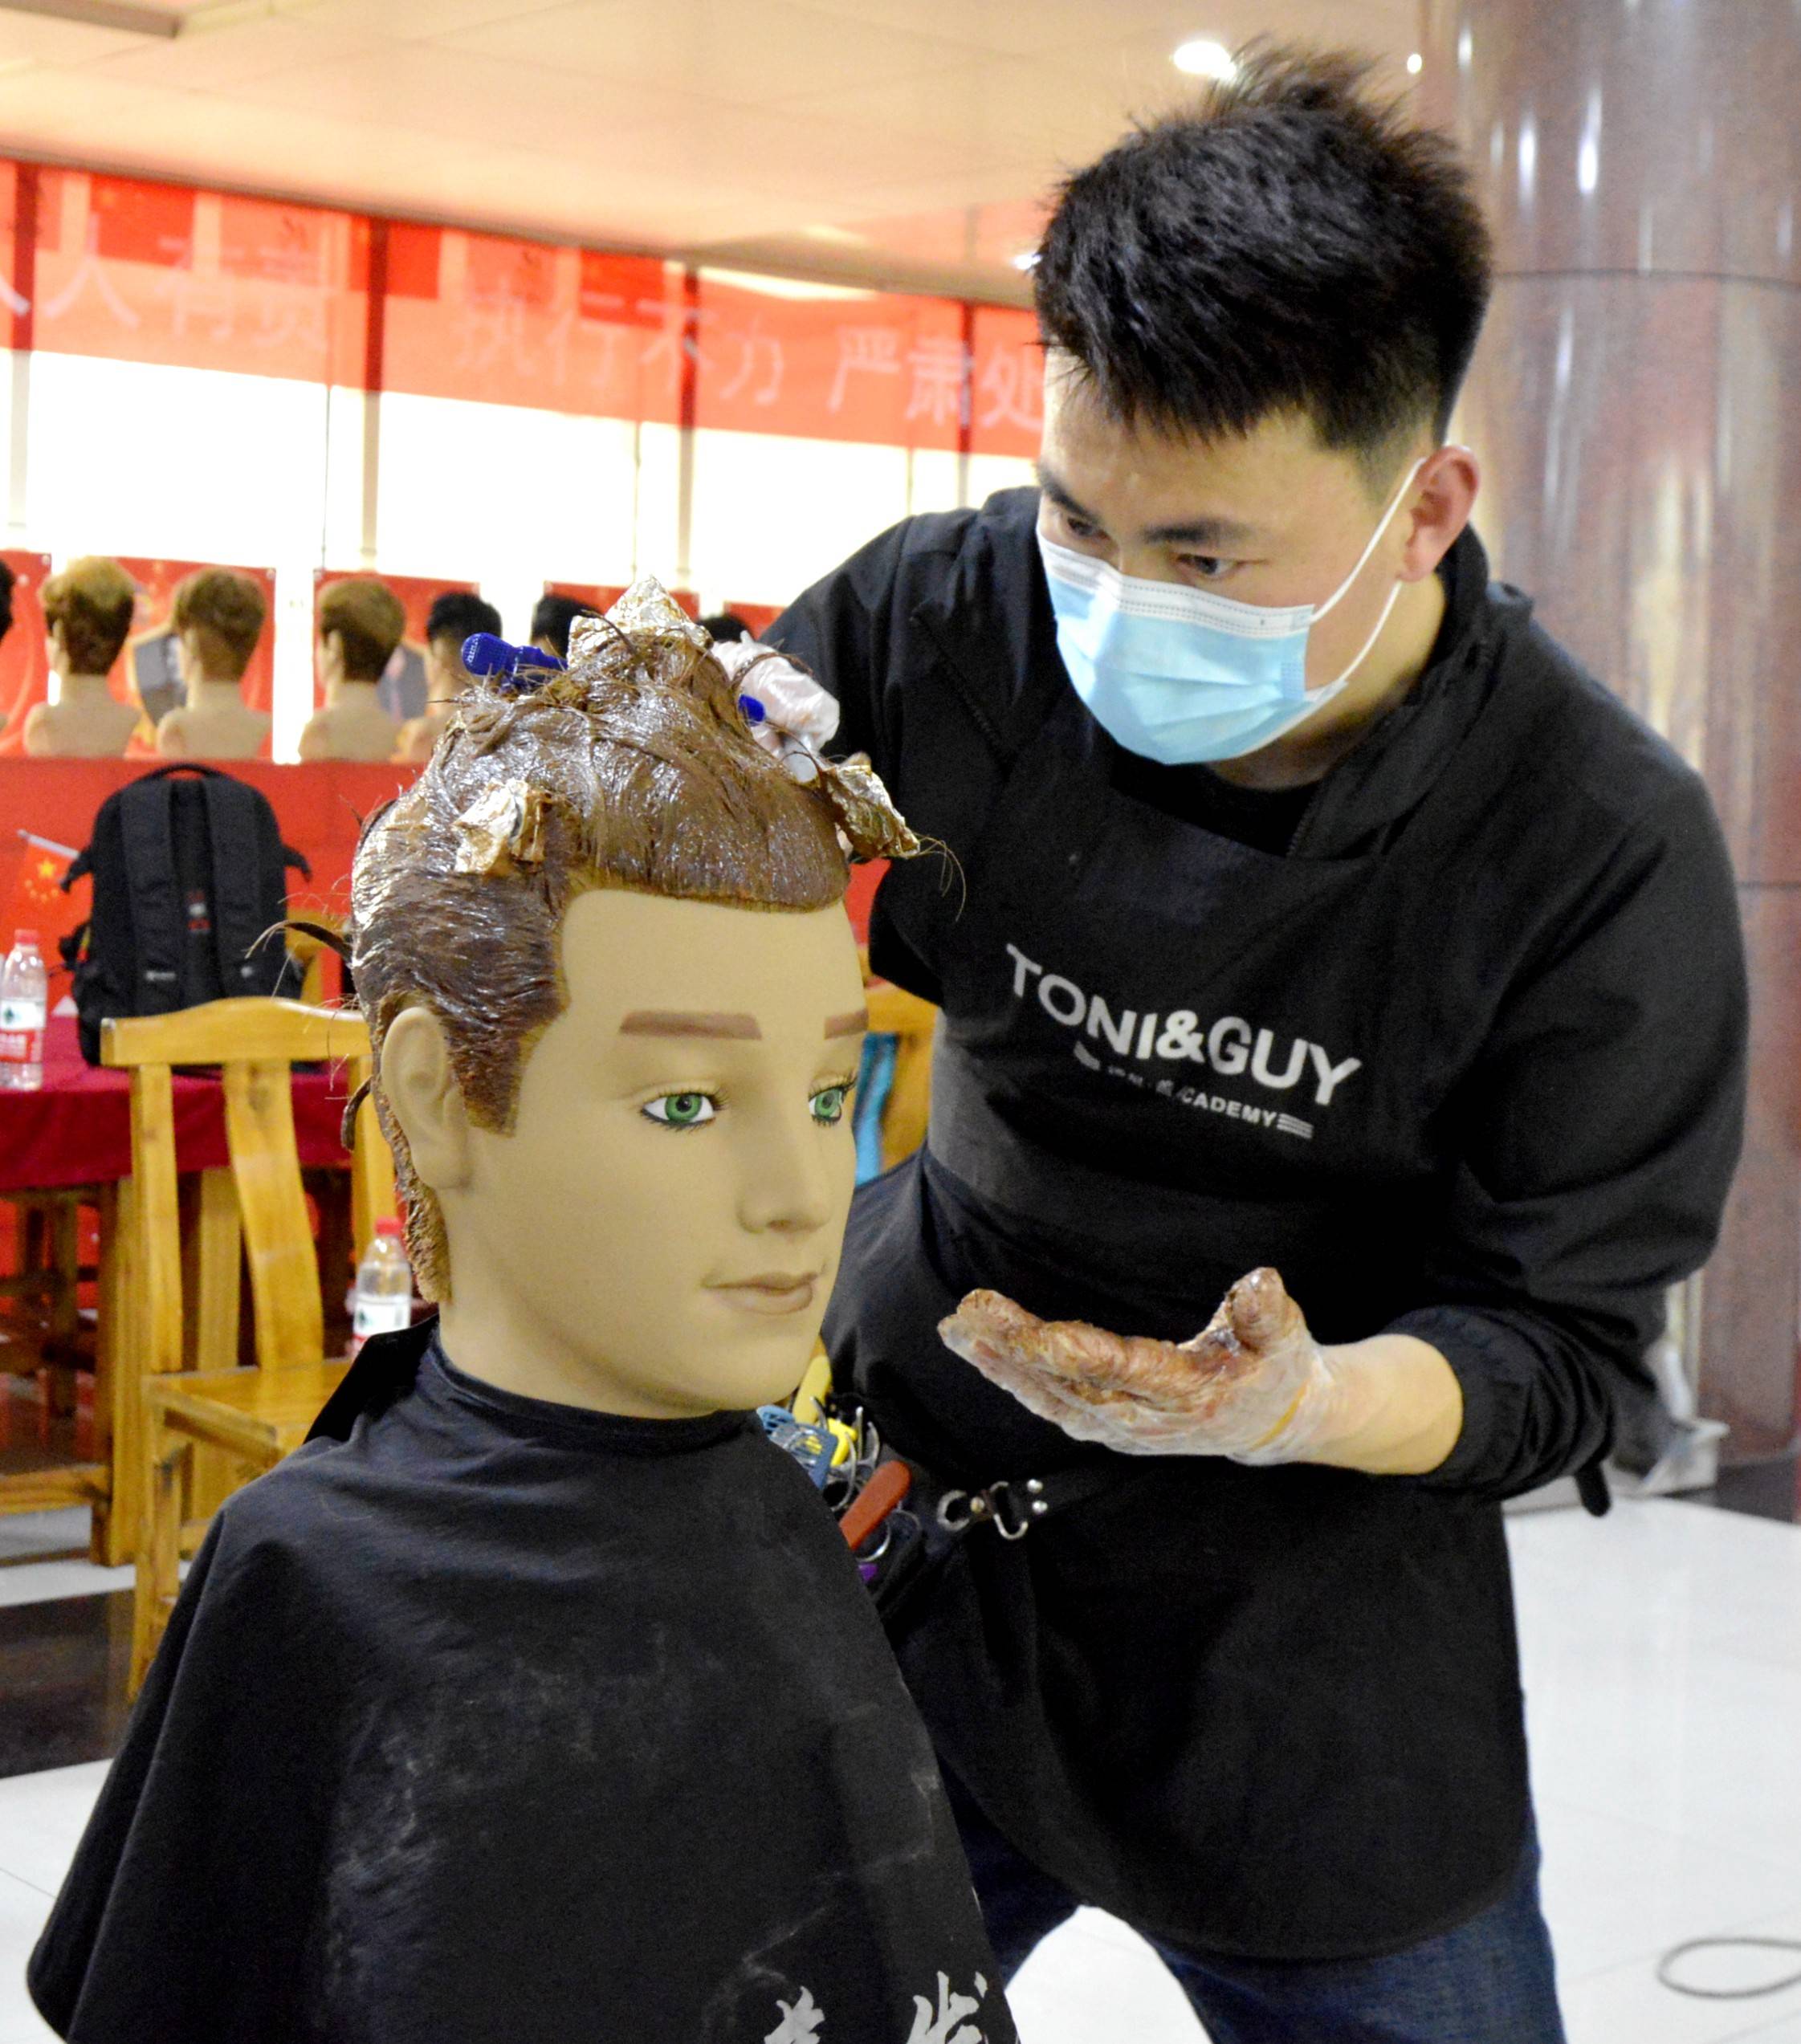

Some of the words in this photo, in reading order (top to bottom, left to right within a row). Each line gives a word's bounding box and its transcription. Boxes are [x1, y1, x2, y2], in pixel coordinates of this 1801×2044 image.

[0, 212, 332, 350] 人有责
[1006, 943, 1362, 1106] TONI&GUY
